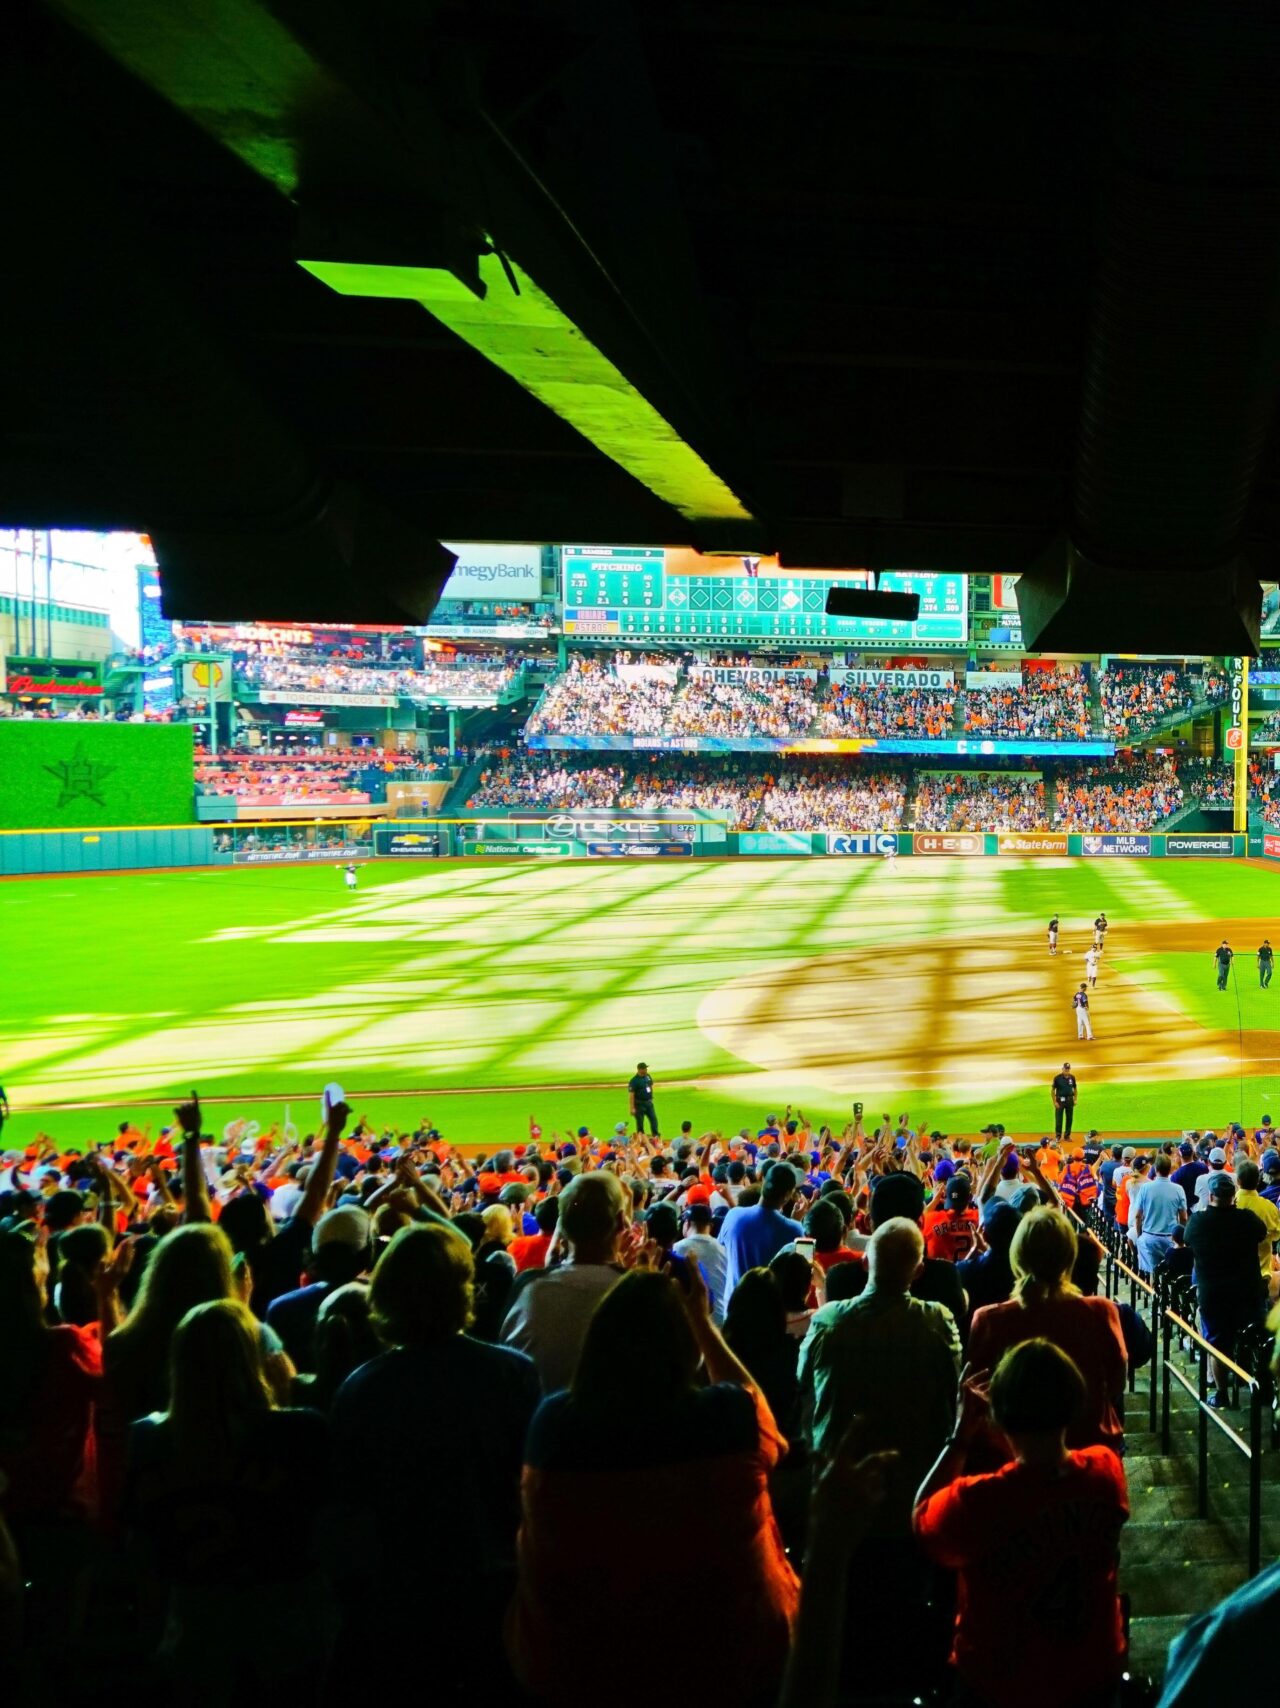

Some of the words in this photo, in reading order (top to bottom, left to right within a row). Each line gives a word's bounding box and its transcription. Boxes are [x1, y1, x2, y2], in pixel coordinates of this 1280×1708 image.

[453, 563, 535, 581] megyBank
[591, 563, 643, 572] PITCHING
[575, 623, 608, 633] ASTROS
[6, 676, 105, 694] Budweiser
[702, 670, 806, 687] CHEVROLET
[845, 671, 941, 687] SILVERADO
[285, 693, 335, 704] TORCHYS
[341, 694, 374, 705] TACOS
[1232, 674, 1242, 728] FOUL
[579, 818, 661, 833] LEXUS
[677, 824, 696, 832] 373
[829, 834, 895, 854] RTIC
[1116, 836, 1136, 844] MLB
[485, 844, 519, 853] National
[1103, 844, 1147, 853] NETWORK
